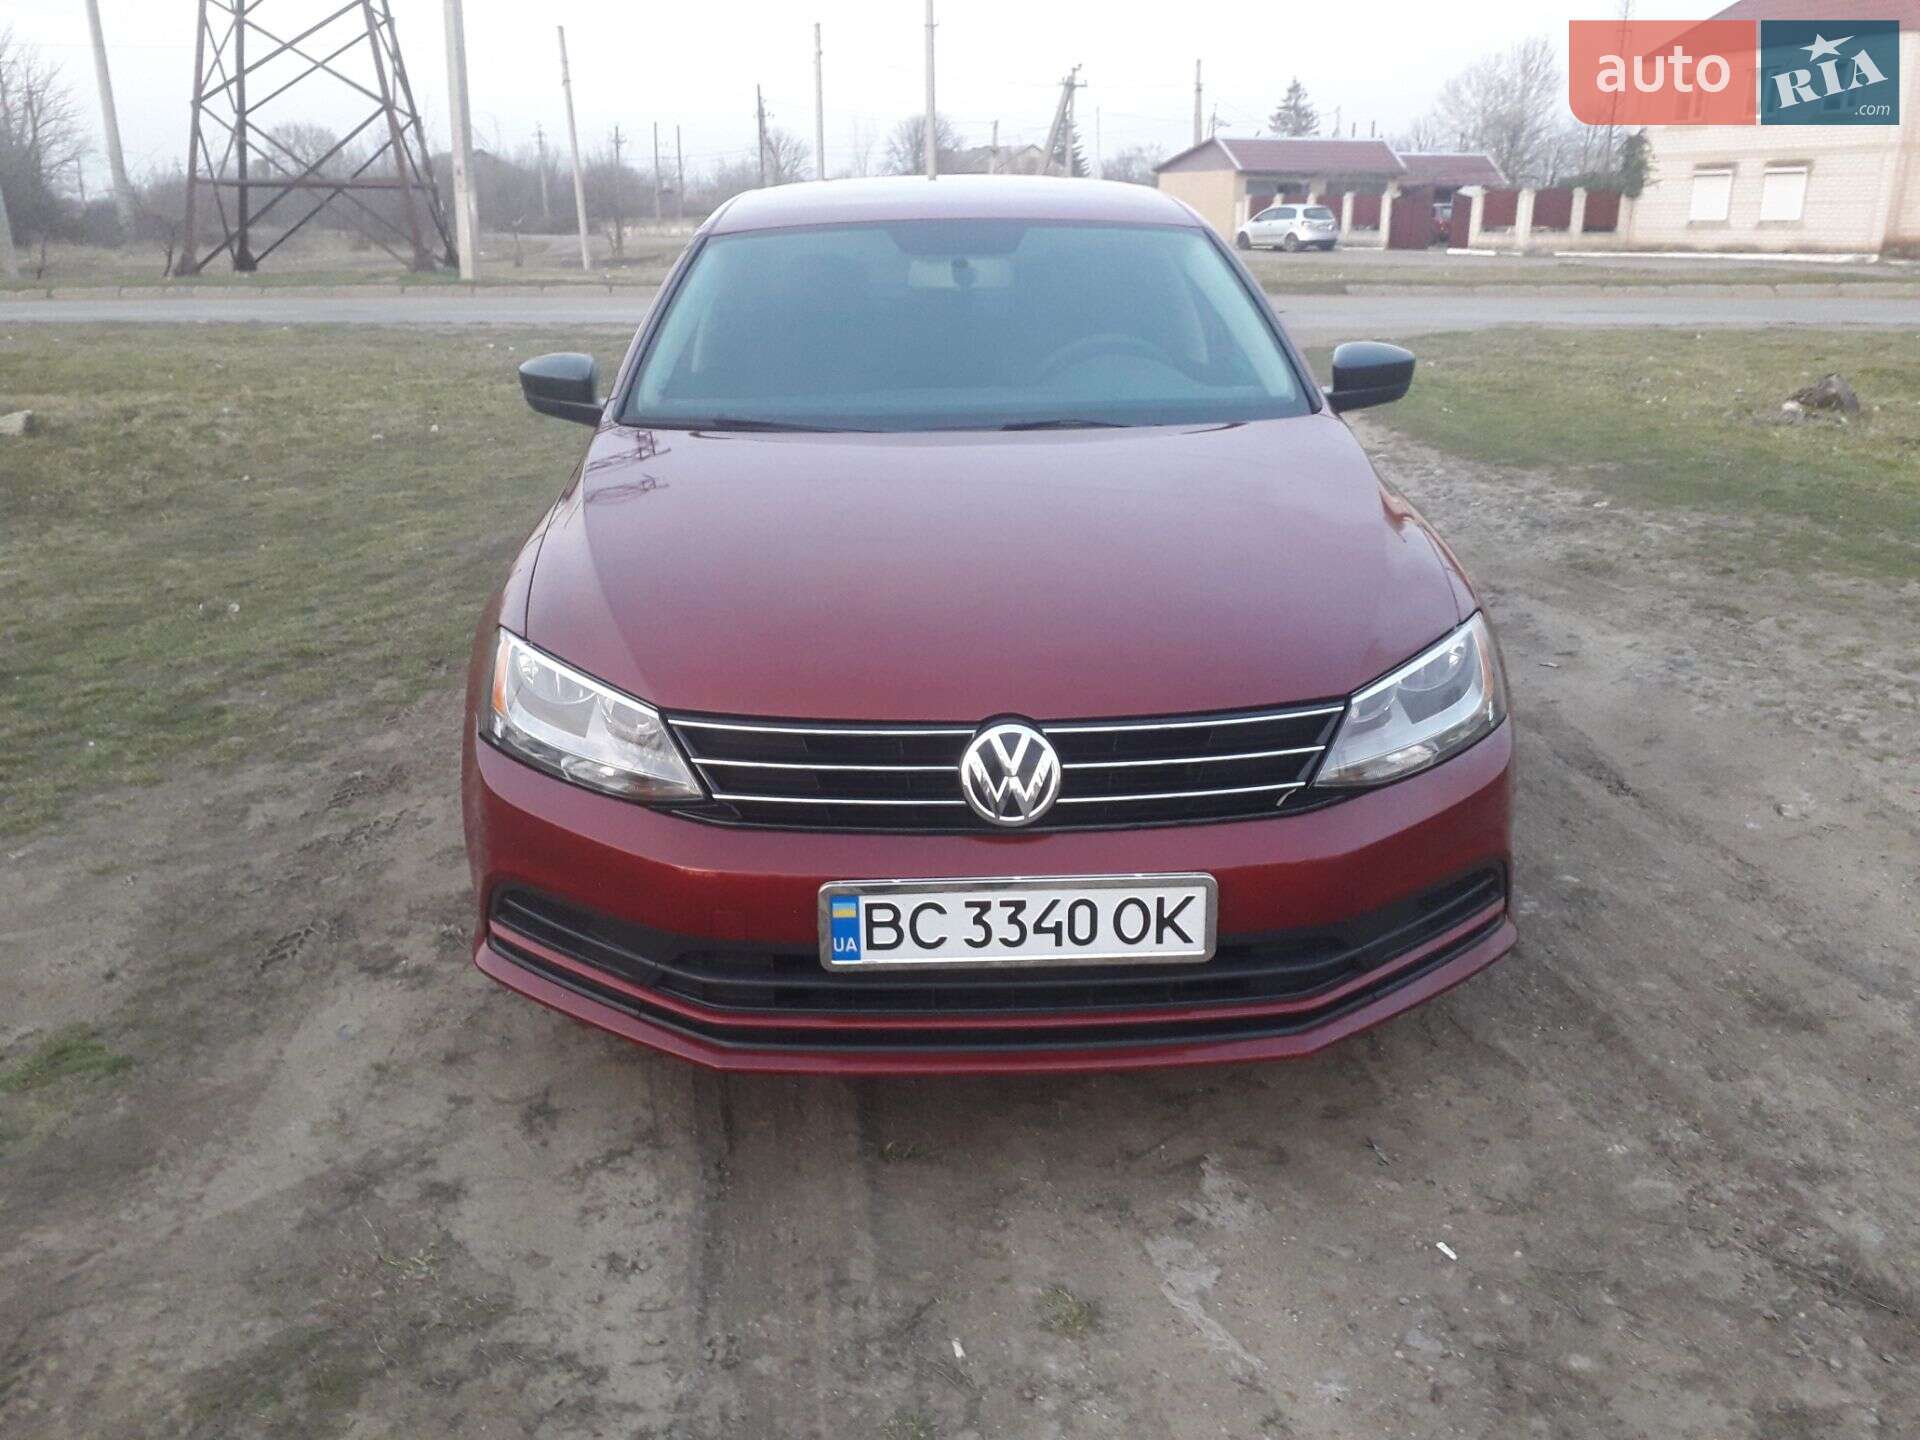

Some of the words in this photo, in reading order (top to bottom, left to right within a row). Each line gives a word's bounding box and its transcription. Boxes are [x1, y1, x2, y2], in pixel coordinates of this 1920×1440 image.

[961, 725, 1060, 826] VW
[833, 937, 858, 953] UA
[864, 901, 948, 951] BC
[963, 898, 1099, 949] 3340
[1112, 895, 1197, 945] OK
